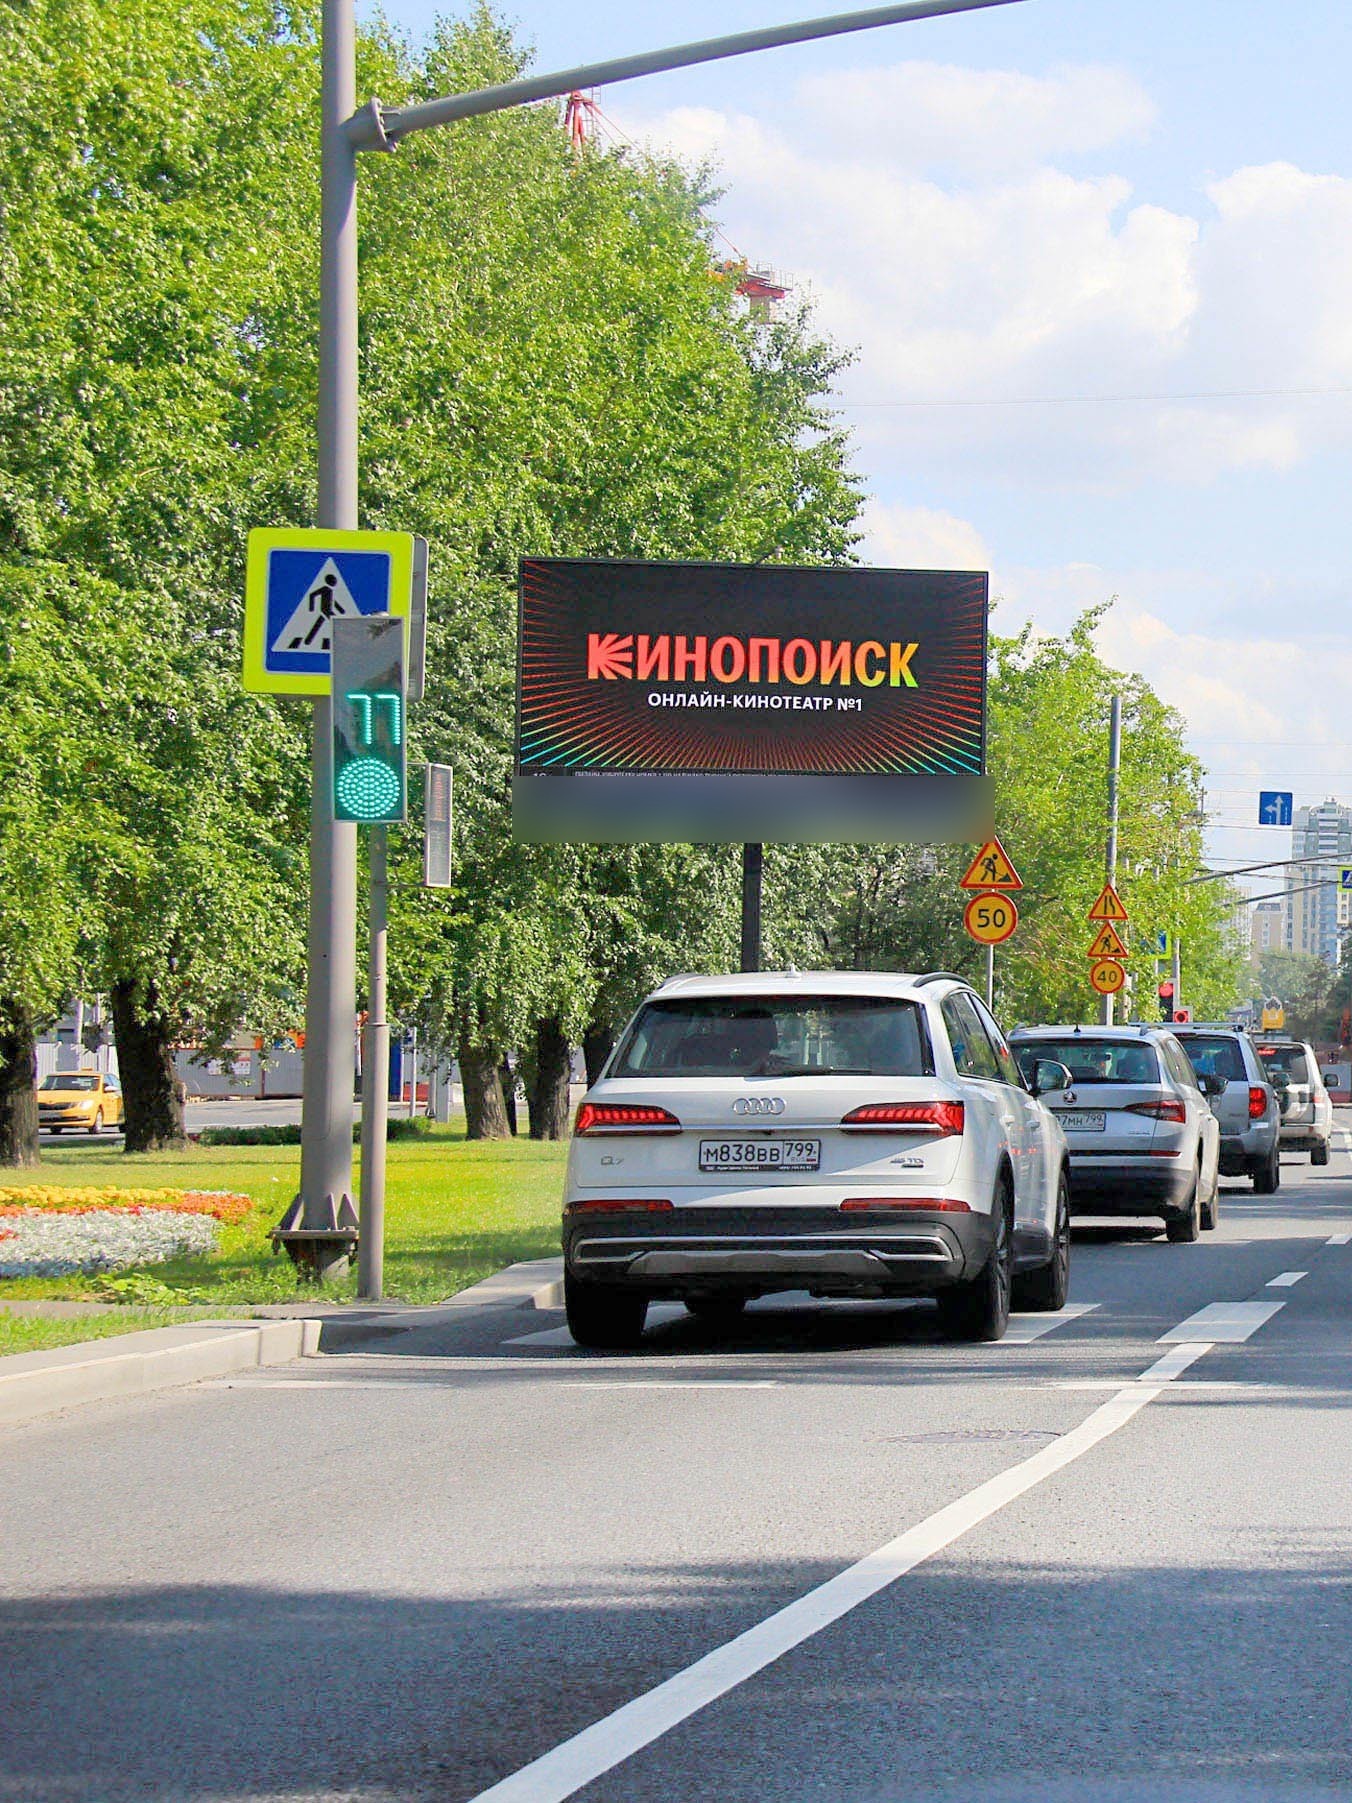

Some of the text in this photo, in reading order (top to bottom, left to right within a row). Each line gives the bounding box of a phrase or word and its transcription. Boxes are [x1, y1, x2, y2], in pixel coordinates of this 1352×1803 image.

[587, 633, 920, 689] КИНОПОИСК
[647, 691, 862, 712] ОНЛАЙН-КИНОТЕАТР №1
[977, 908, 1006, 928] 50
[1097, 970, 1117, 983] 40
[785, 1142, 815, 1157] 799
